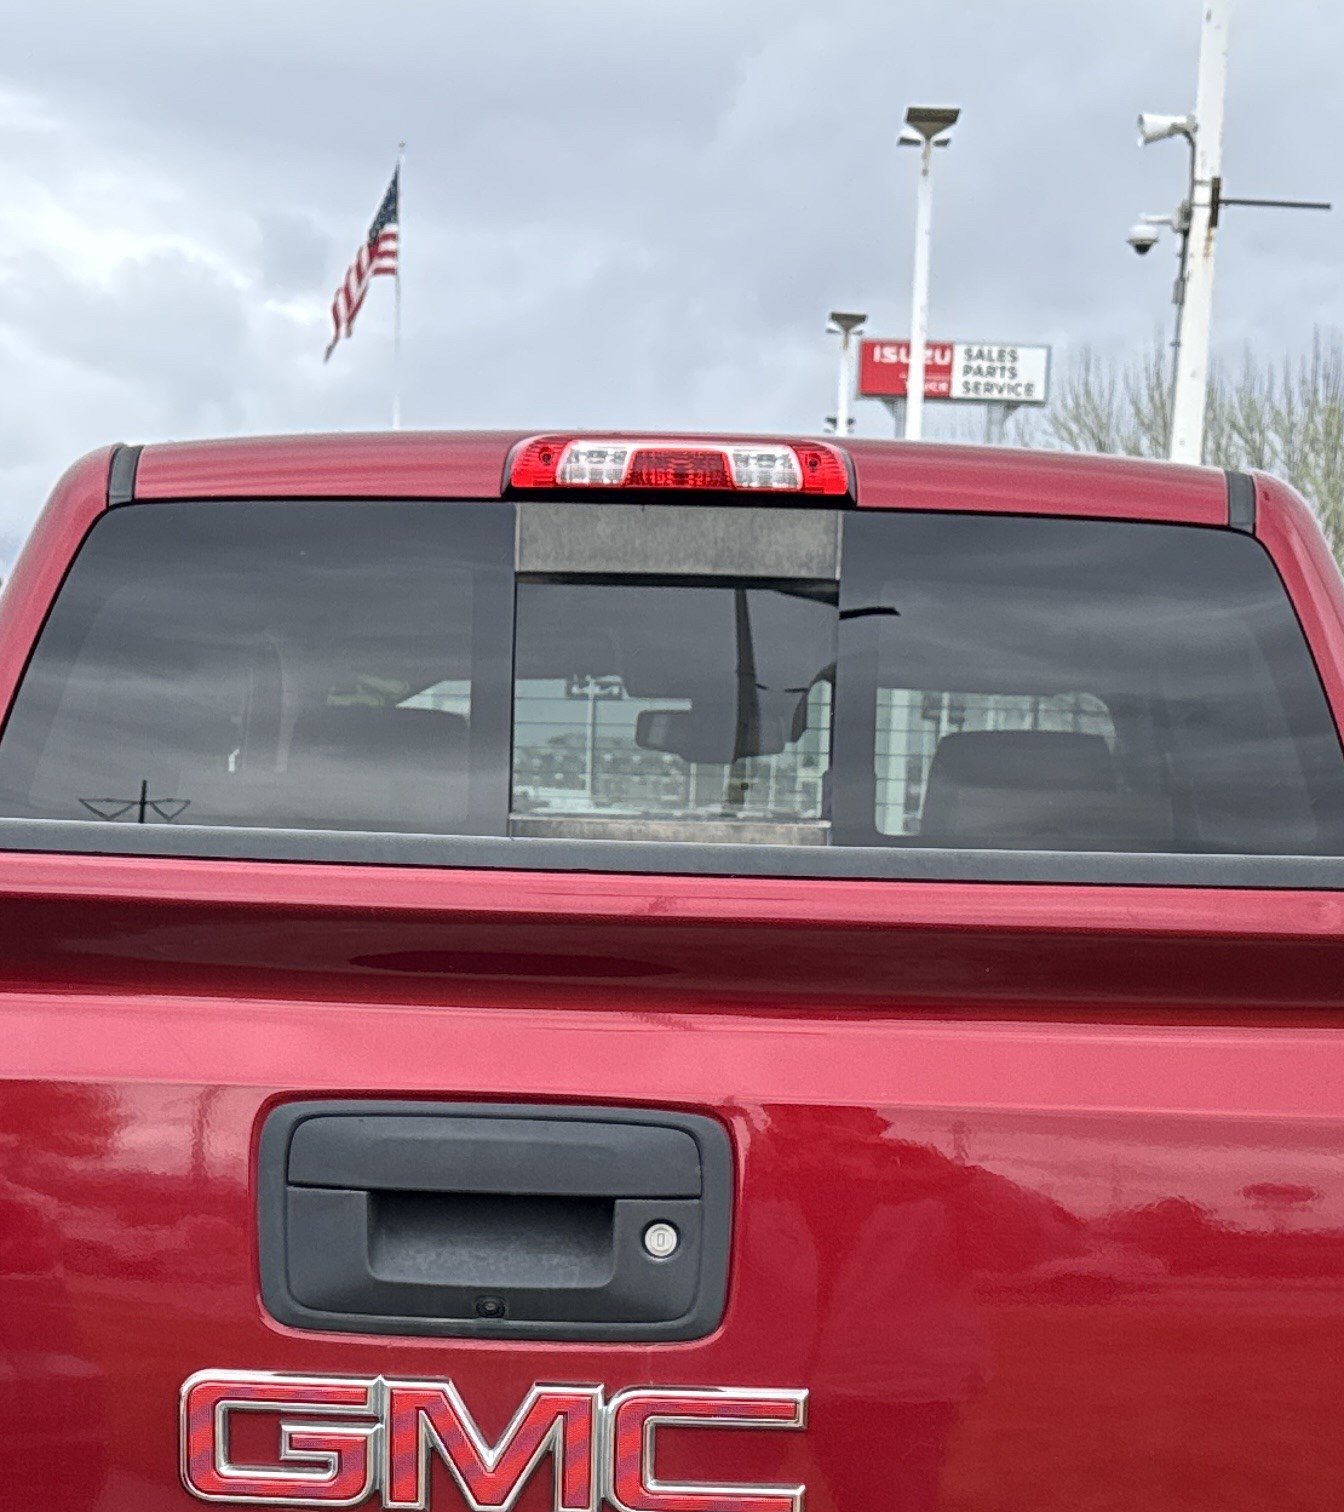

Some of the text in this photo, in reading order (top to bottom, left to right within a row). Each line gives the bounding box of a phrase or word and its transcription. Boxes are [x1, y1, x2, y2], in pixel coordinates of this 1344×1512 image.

[963, 347, 1019, 363] SALES
[962, 364, 1018, 380] PARTS
[961, 380, 1035, 397] SERVICE
